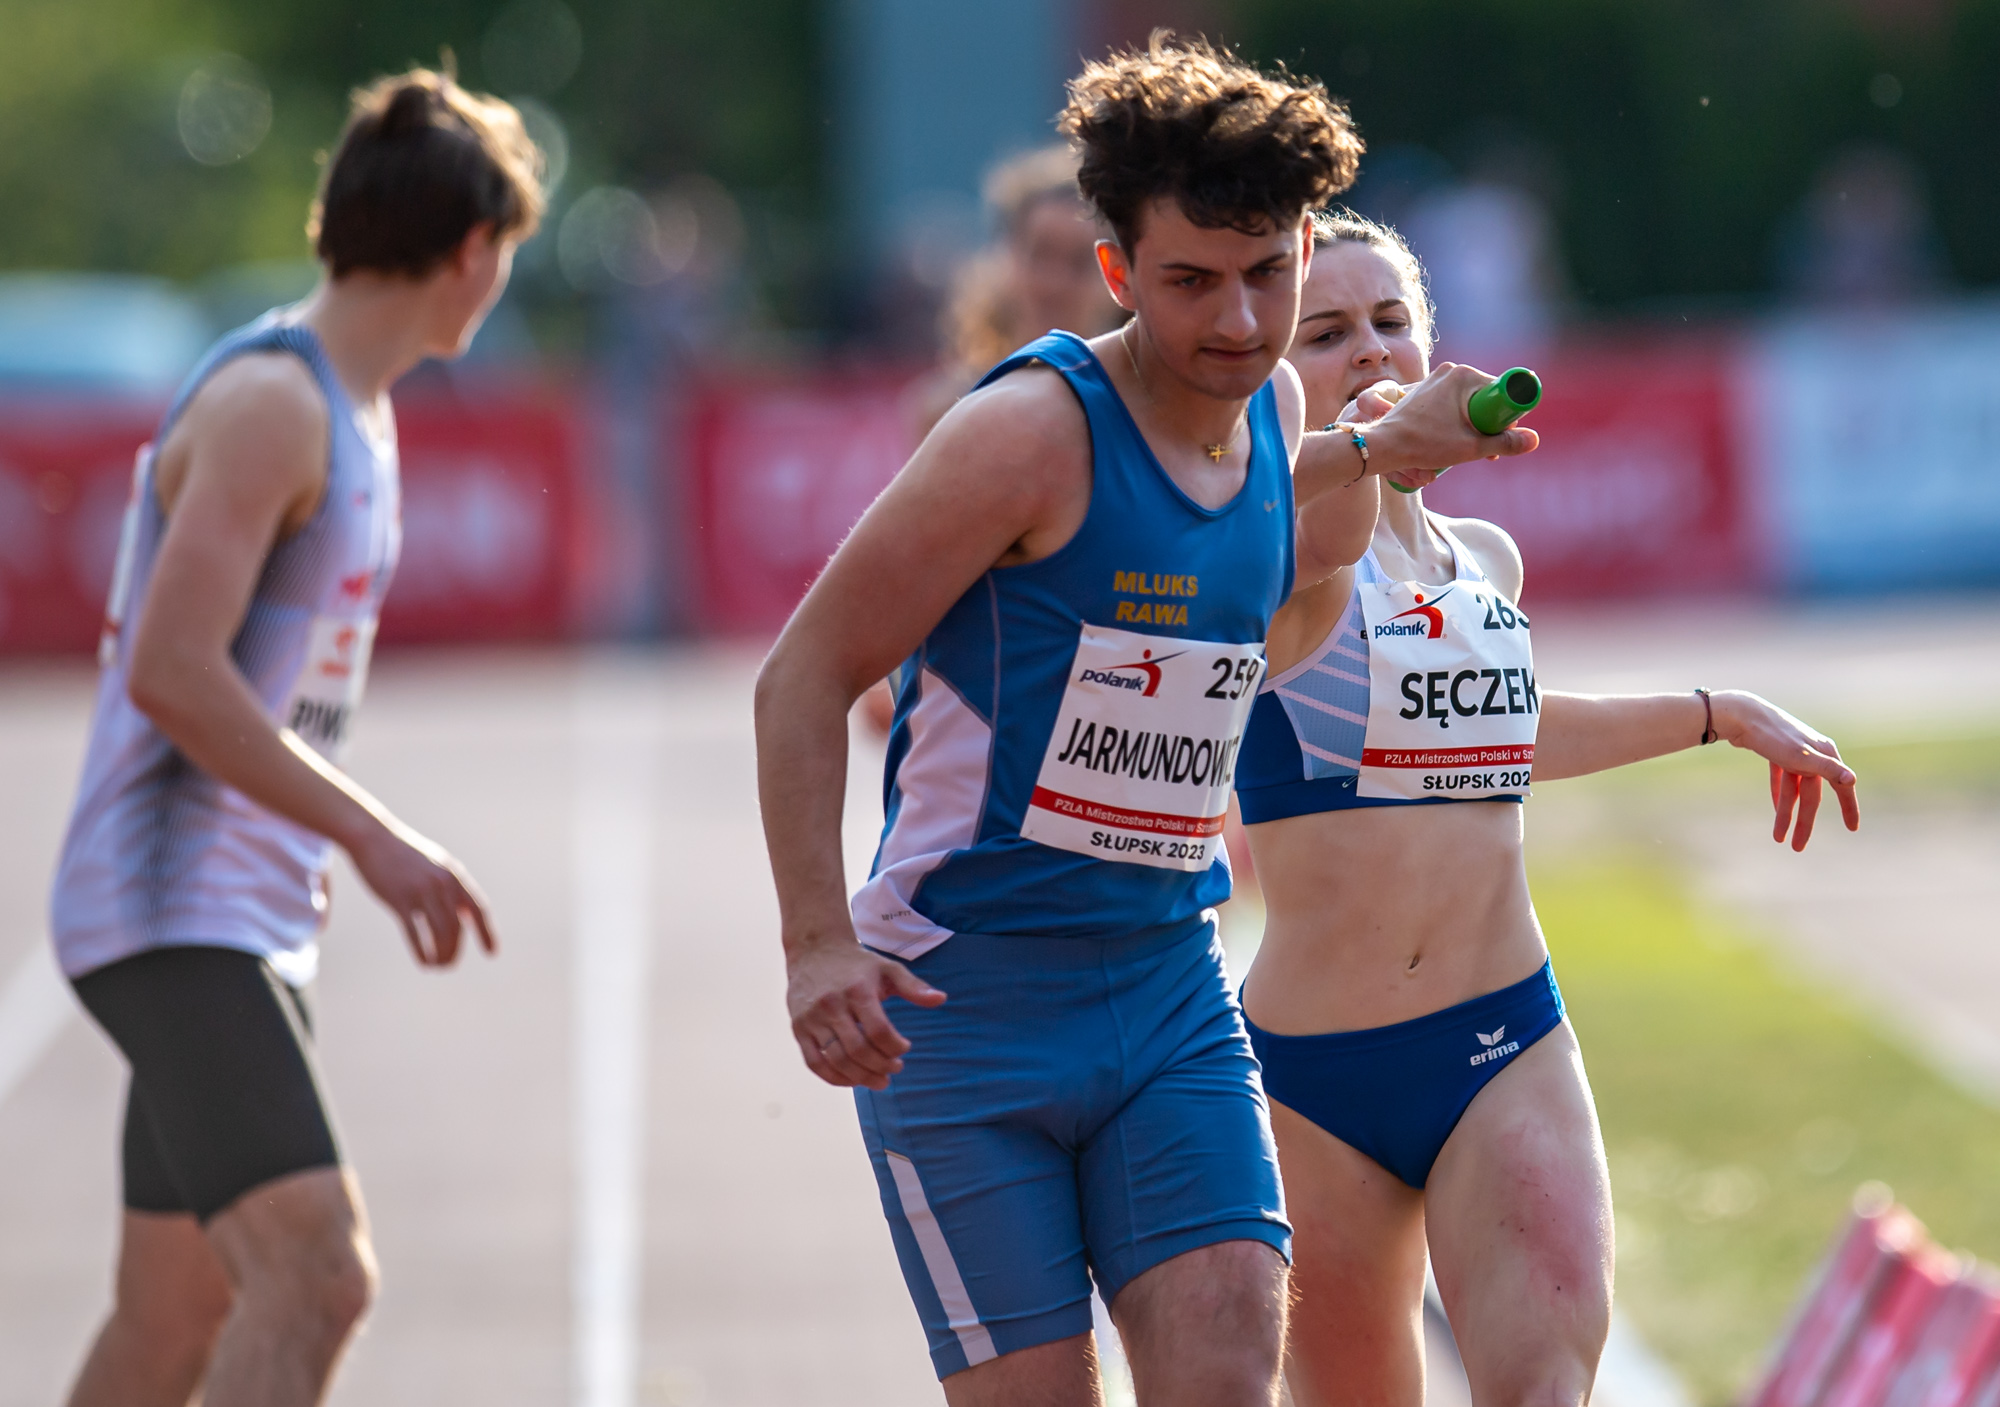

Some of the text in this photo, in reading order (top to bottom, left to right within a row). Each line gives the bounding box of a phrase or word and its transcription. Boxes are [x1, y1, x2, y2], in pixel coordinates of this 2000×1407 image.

[1113, 570, 1199, 597] MLUKS
[1116, 601, 1188, 626] RAWA
[1374, 621, 1427, 639] polanik
[1079, 669, 1146, 691] polanik
[1203, 657, 1260, 701] 259
[1399, 668, 1540, 729] SĘCZEK
[1384, 754, 1412, 765] PZLA
[1414, 752, 1479, 765] Mistrzostwa
[1480, 749, 1511, 762] Polski
[1512, 751, 1522, 760] w
[1423, 773, 1496, 790] SŁUPSK
[1054, 797, 1084, 816] PZLA
[1086, 805, 1154, 828] Mistrzostwa
[1155, 817, 1187, 832] Polski
[1090, 831, 1206, 861] SŁUPSK 2023
[1470, 1041, 1519, 1066] erima
